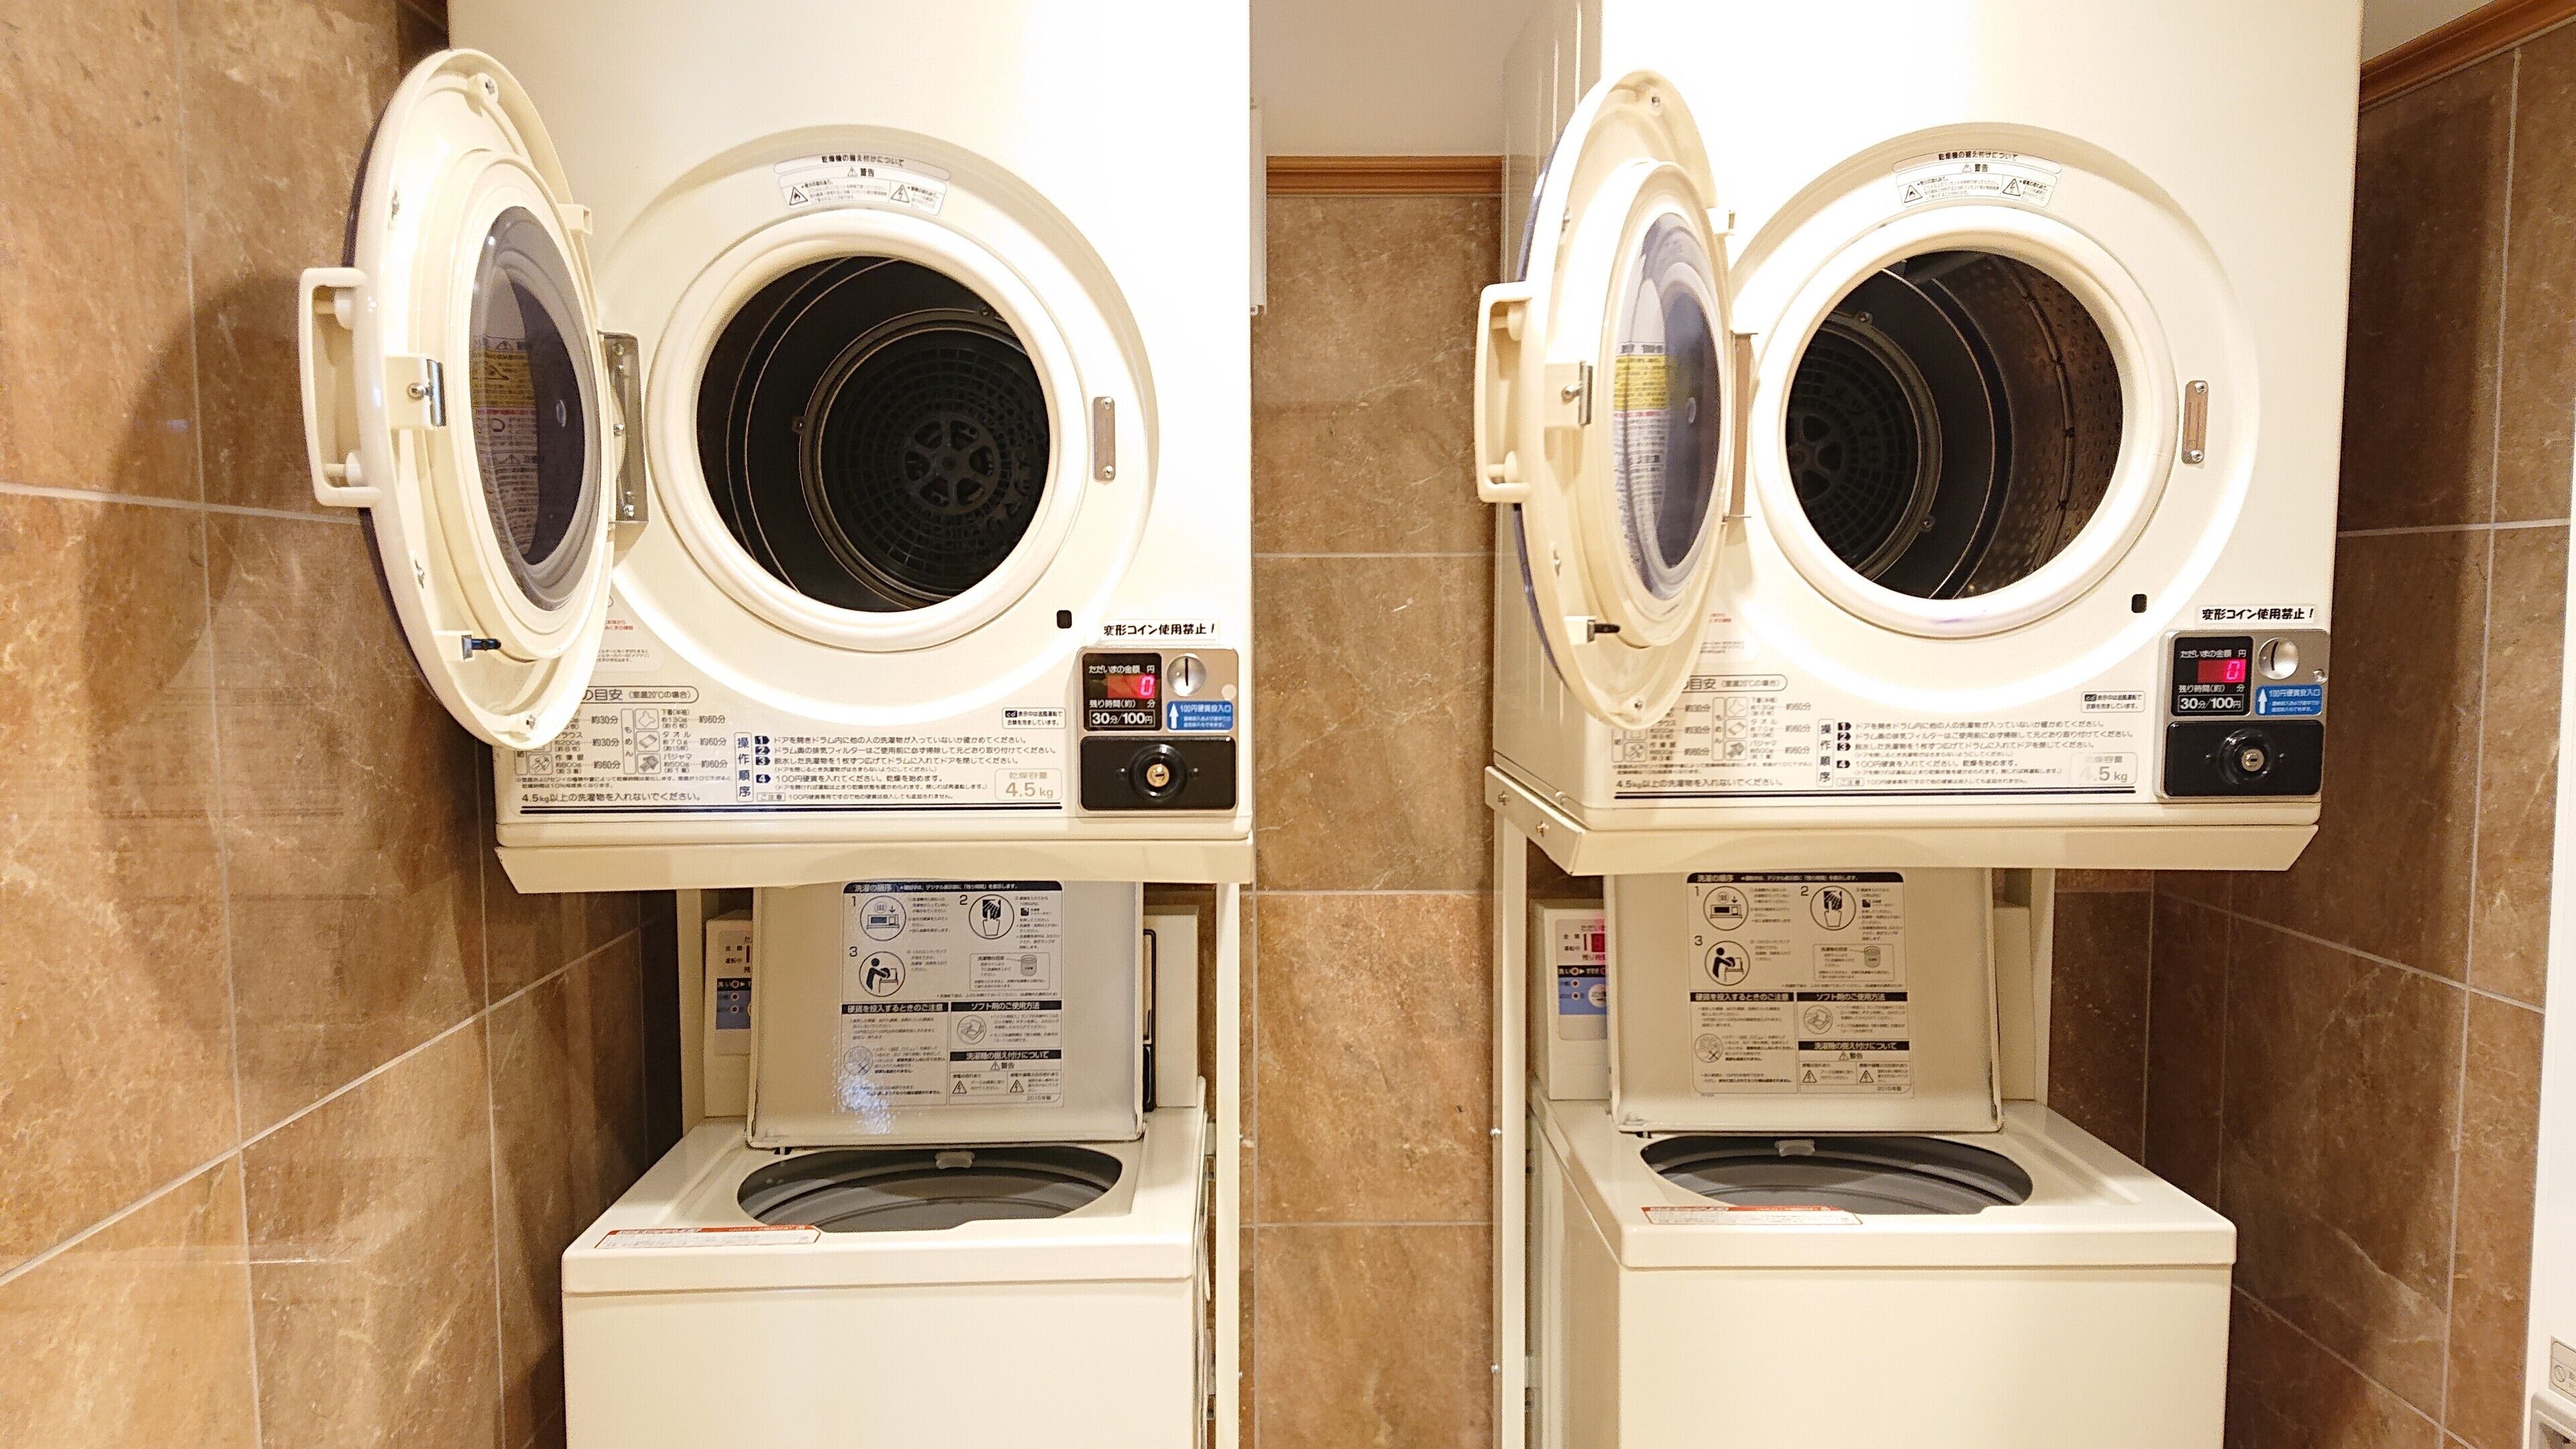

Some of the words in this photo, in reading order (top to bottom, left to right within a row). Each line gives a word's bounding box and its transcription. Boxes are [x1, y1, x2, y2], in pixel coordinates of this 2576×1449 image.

[2202, 608, 2314, 620] 変形コイン使用禁止！
[1104, 624, 1215, 636] 変形コイン使用禁止！
[2180, 649, 2232, 658] ただいまの金額
[2238, 649, 2247, 657] 円
[1089, 665, 1140, 674] ただいまの金額
[1146, 665, 1155, 674] 円
[2226, 660, 2241, 680] 0
[1140, 676, 1154, 696] 0
[1684, 678, 1716, 690] 目安
[2236, 684, 2245, 692] 分
[1146, 699, 1156, 708] 分
[591, 715, 619, 724] 約30分
[699, 714, 726, 724] 約60分
[592, 738, 619, 747] 約30分
[700, 737, 727, 746] 約60分
[701, 759, 728, 768] 約60分
[2084, 755, 2123, 763] 燥容量
[737, 737, 751, 797] 操作順序
[2114, 771, 2128, 783] kg
[1006, 782, 1036, 797] 4.5
[1039, 788, 1053, 799] kg
[1801, 885, 1809, 896] 2
[851, 896, 857, 907] 1
[959, 895, 968, 906] 2
[1694, 935, 1703, 946] 3
[849, 946, 858, 957] 3
